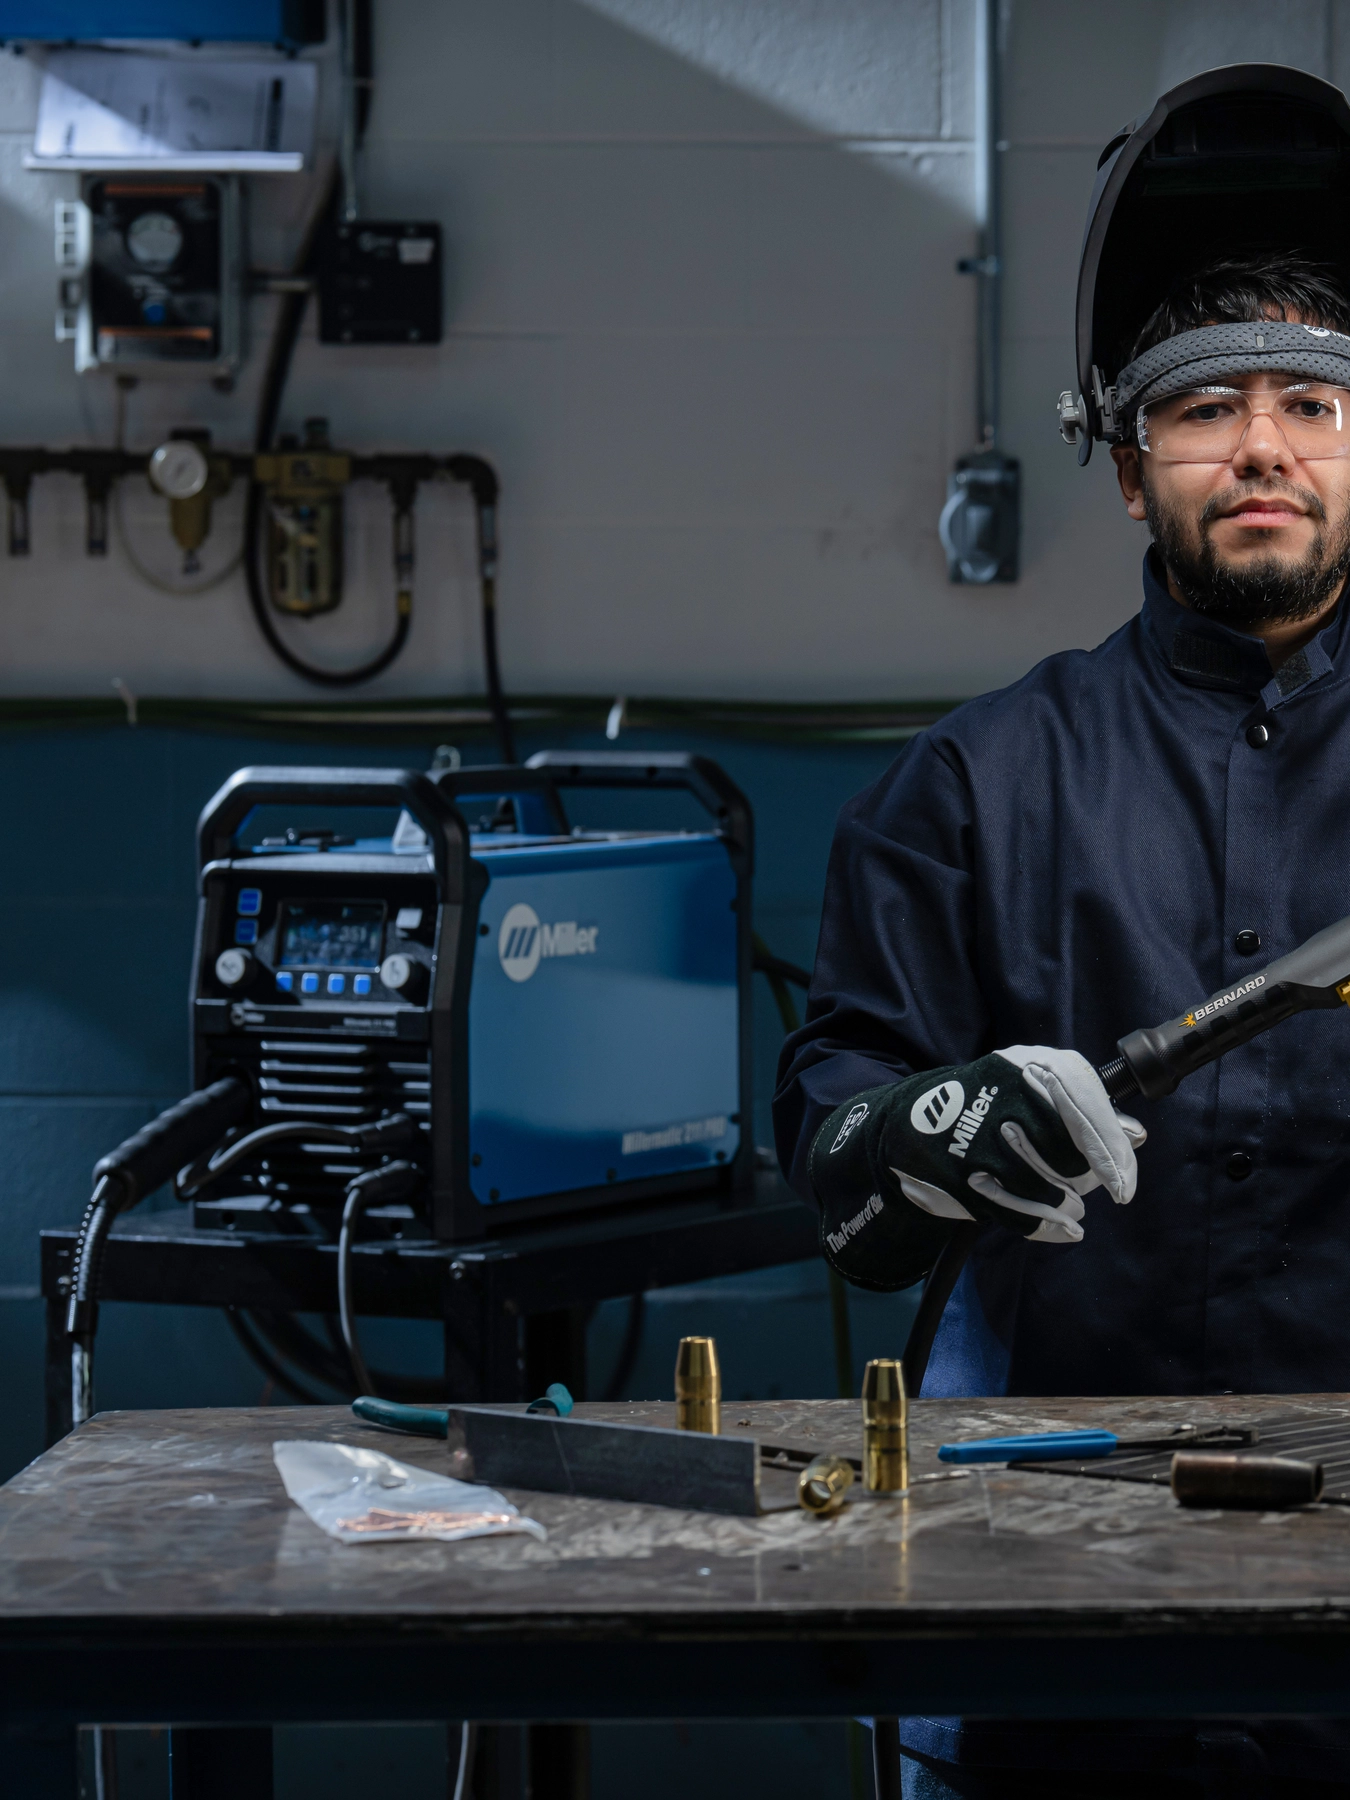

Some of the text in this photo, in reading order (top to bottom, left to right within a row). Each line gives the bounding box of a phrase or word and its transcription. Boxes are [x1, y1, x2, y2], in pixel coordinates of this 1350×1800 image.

[541, 920, 599, 957] Miller
[1194, 975, 1266, 1021] BERNARD
[947, 1085, 994, 1159] Miller
[826, 1231, 847, 1254] The
[840, 1221, 867, 1241] Power
[863, 1199, 874, 1221] of
